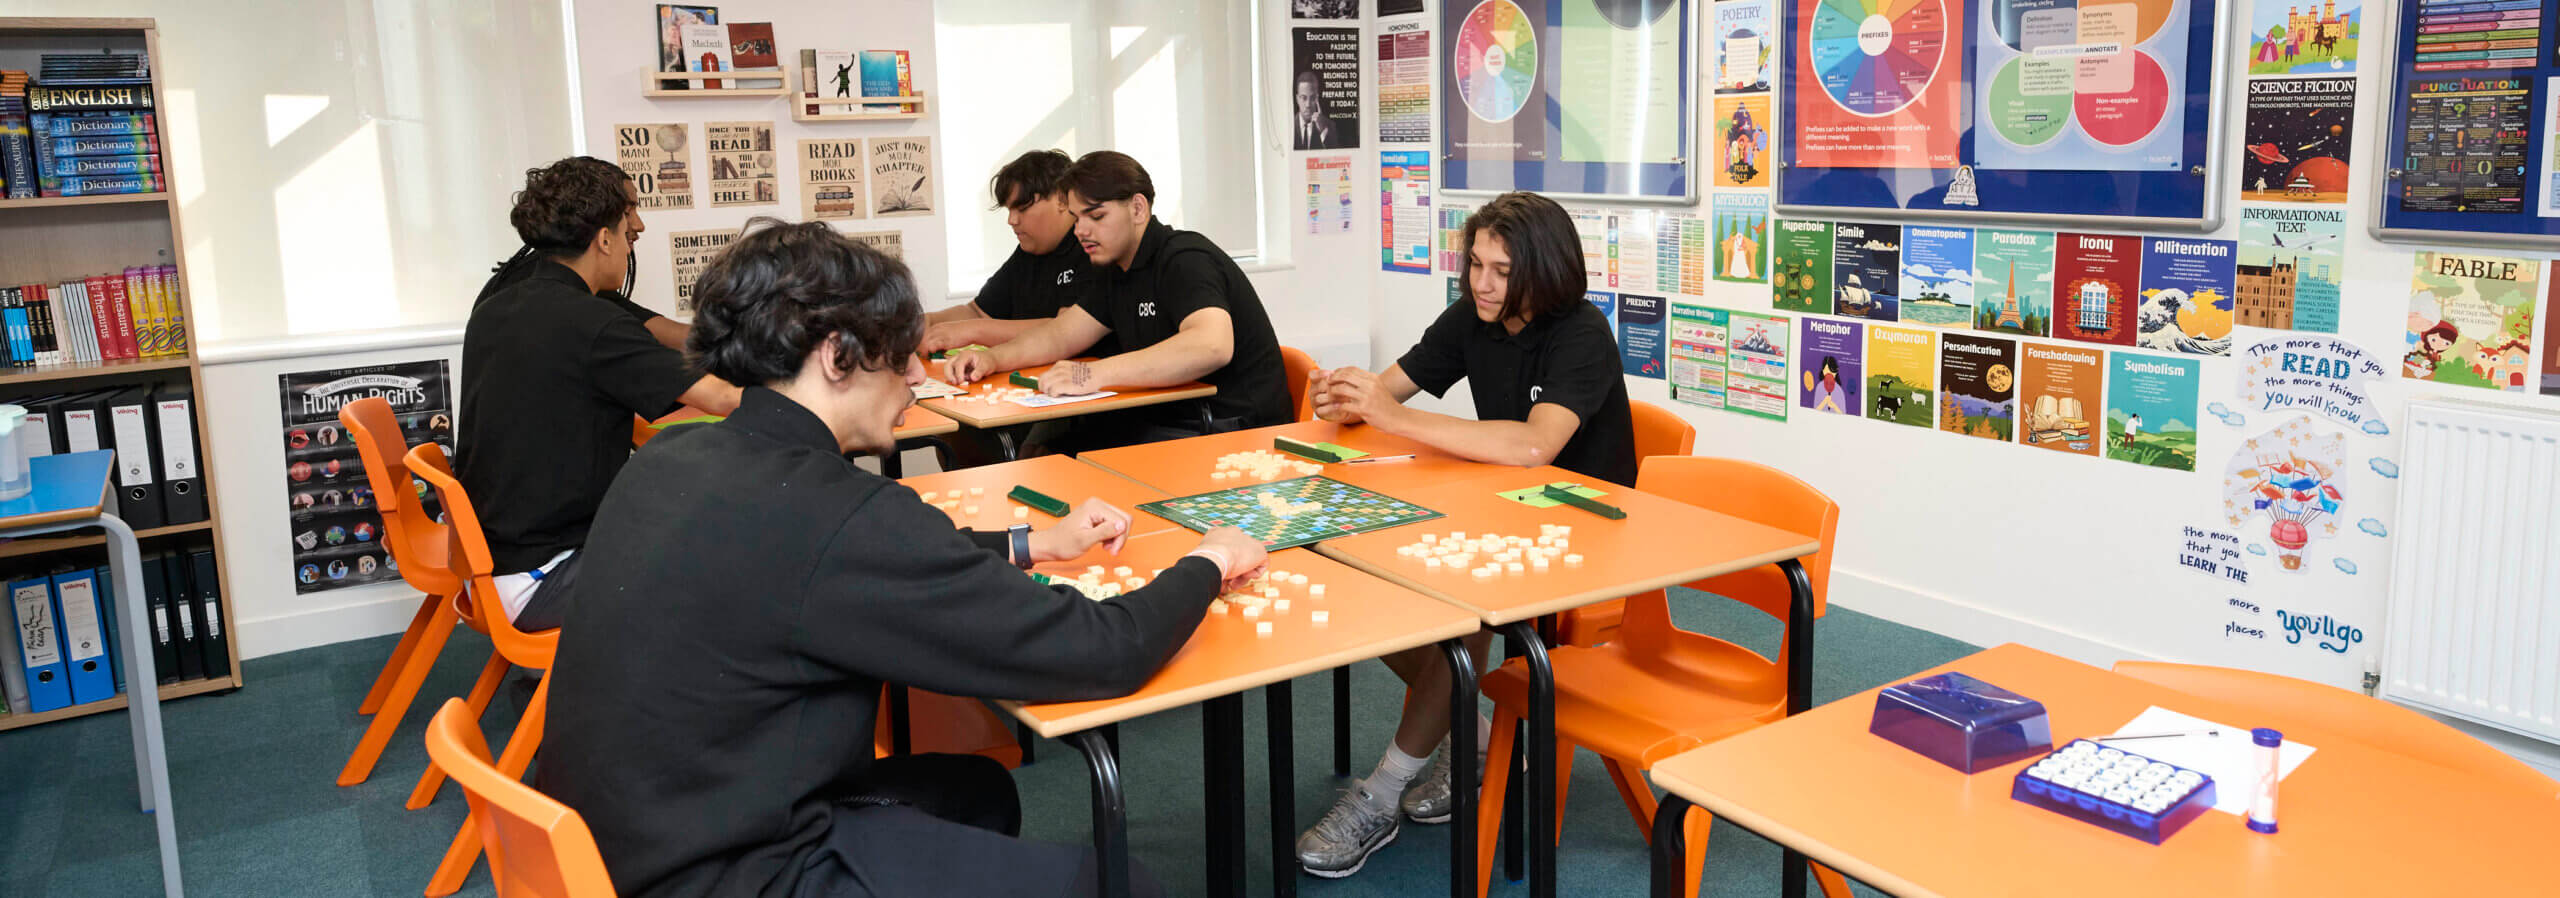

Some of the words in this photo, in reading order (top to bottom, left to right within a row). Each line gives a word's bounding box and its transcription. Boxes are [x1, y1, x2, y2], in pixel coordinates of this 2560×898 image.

[1722, 6, 1762, 21] POETRY
[1306, 32, 1339, 40] EDUCATION
[2250, 82, 2302, 93] SCIENCE
[2304, 80, 2355, 93] FICTION
[2420, 79, 2519, 92] PUNCTUATION
[50, 88, 133, 106] ENGLISH
[71, 120, 131, 132] Dictionary
[620, 127, 650, 147] SO
[75, 141, 136, 152] Dictionary
[710, 139, 750, 150] READ
[809, 142, 856, 159] READ
[875, 142, 900, 153] JUST
[904, 142, 925, 154] ONE
[11, 131, 26, 185] THESAURUS
[621, 148, 650, 159] MANY
[78, 161, 137, 172] Dictionary
[622, 161, 651, 171] BOOKS
[822, 160, 841, 168] MORE
[875, 162, 925, 175] CHAPTER
[810, 168, 855, 182] BOOKS
[82, 180, 142, 191] Dictionary
[666, 195, 693, 207] TIME
[714, 190, 751, 202] FREE
[2243, 208, 2342, 222] INFORMATIONAL
[1782, 220, 1825, 233] Hyperbole
[1837, 226, 1864, 238] Simile
[1912, 228, 1966, 239] Onomatopoeia
[884, 234, 900, 245] THE
[1992, 232, 2036, 245] Paradox
[2079, 236, 2113, 253] Irony
[2153, 240, 2228, 257] Alliteration
[676, 256, 695, 265] CAN
[2440, 257, 2518, 281] FABLE
[1611, 275, 1616, 284] 5
[1584, 293, 1610, 303] STION
[1626, 297, 1656, 308] PREDICT
[94, 291, 110, 339] Thesaurus
[113, 290, 128, 337] Thesaurus
[1673, 306, 1694, 317] Narrative
[1695, 311, 1715, 320] Writing
[1810, 321, 1851, 336] Metaphor
[1875, 328, 1928, 345] Oxymoron
[1944, 341, 2001, 356] Personification
[2027, 348, 2096, 366] Foreshadowing
[2248, 343, 2278, 357] The
[2286, 340, 2321, 349] more
[2329, 341, 2362, 360] that
[2360, 360, 2384, 377] you
[2124, 360, 2185, 377] Symbolism
[2281, 352, 2350, 380] READ
[2265, 377, 2285, 387] the
[2292, 378, 2322, 387] more
[2329, 382, 2365, 406] things
[2298, 395, 2322, 408] will
[2184, 526, 2204, 537] the
[2210, 532, 2239, 544] more
[2186, 540, 2213, 554] that
[2220, 548, 2239, 561] you
[2180, 553, 2217, 574] LEARN
[2225, 566, 2248, 583] THE
[2229, 598, 2260, 613] more
[2226, 621, 2264, 639] places
[2319, 625, 2362, 653] go
